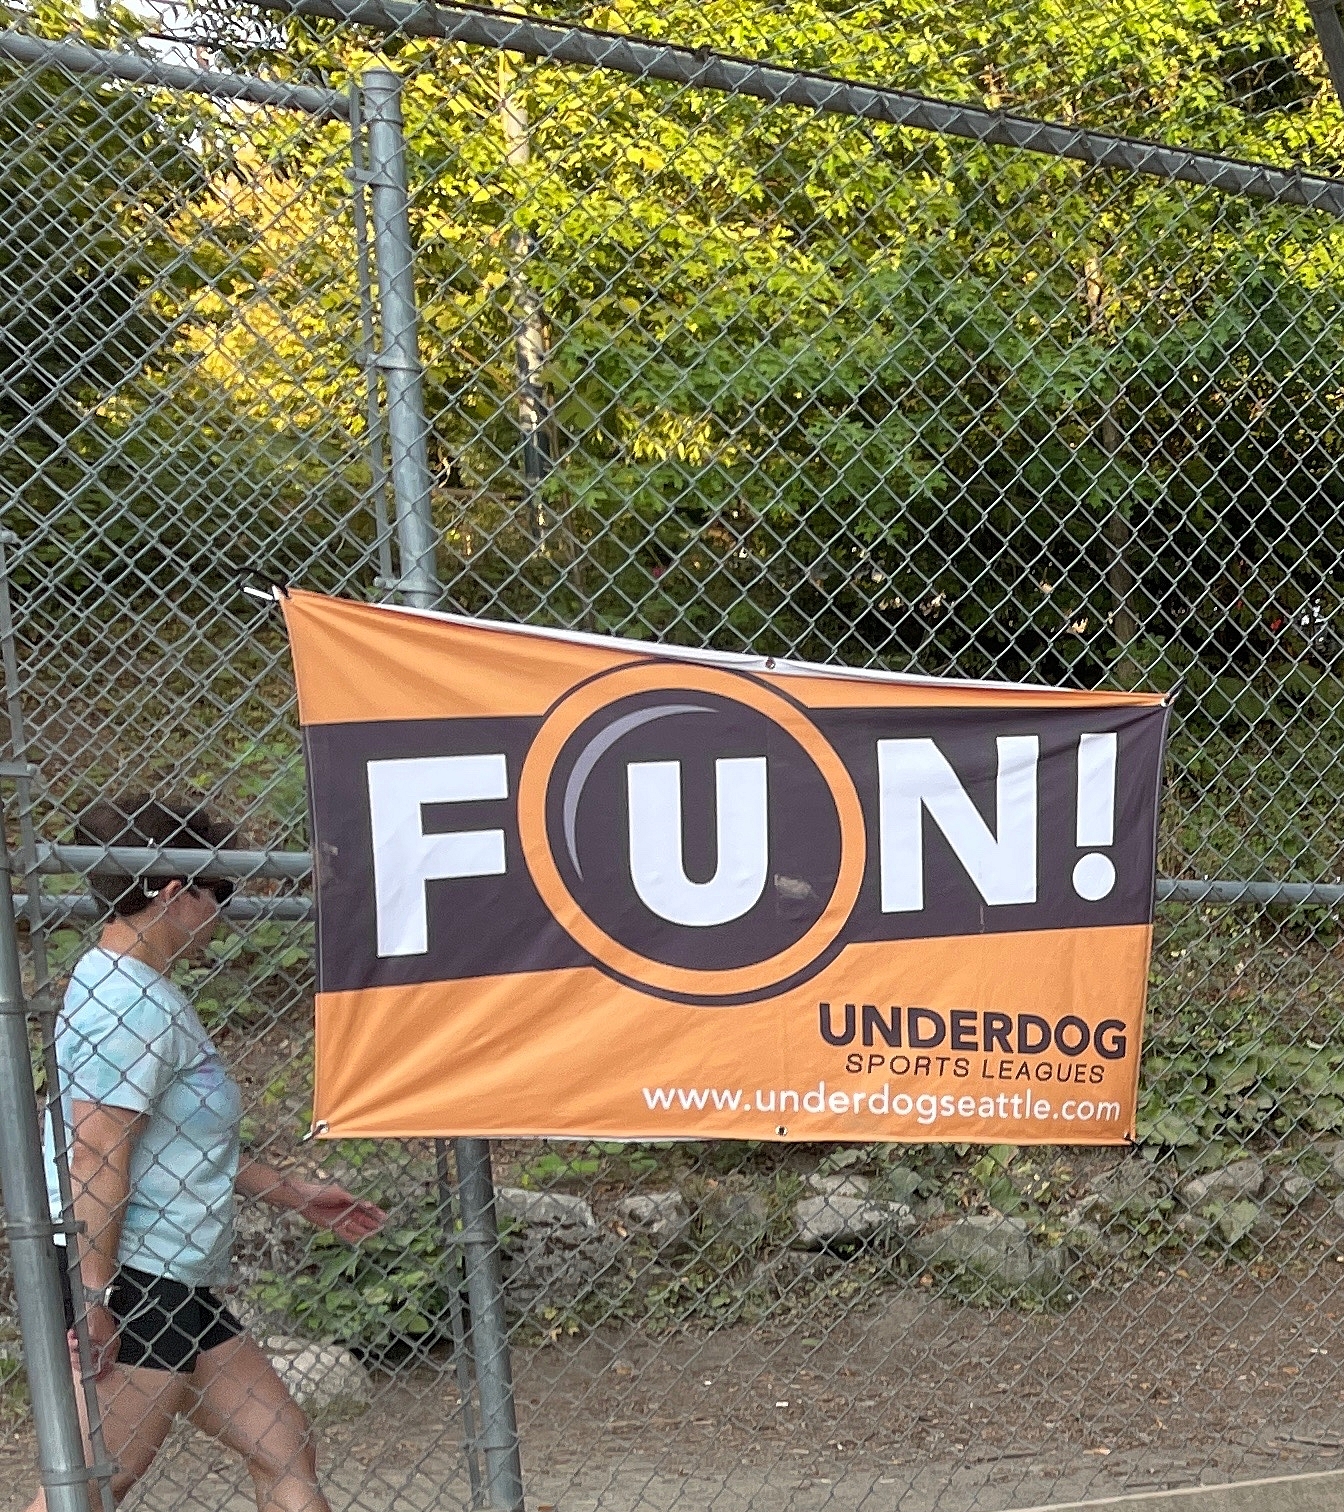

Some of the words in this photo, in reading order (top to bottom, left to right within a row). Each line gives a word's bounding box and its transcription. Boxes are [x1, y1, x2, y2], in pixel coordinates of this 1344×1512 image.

[366, 731, 1118, 959] FUN!
[818, 1001, 1128, 1060] UNDERDOG
[845, 1053, 971, 1079] SPORTS
[981, 1058, 1106, 1084] LEAGUES
[641, 1081, 1121, 1125] www.underdogseattle.com
